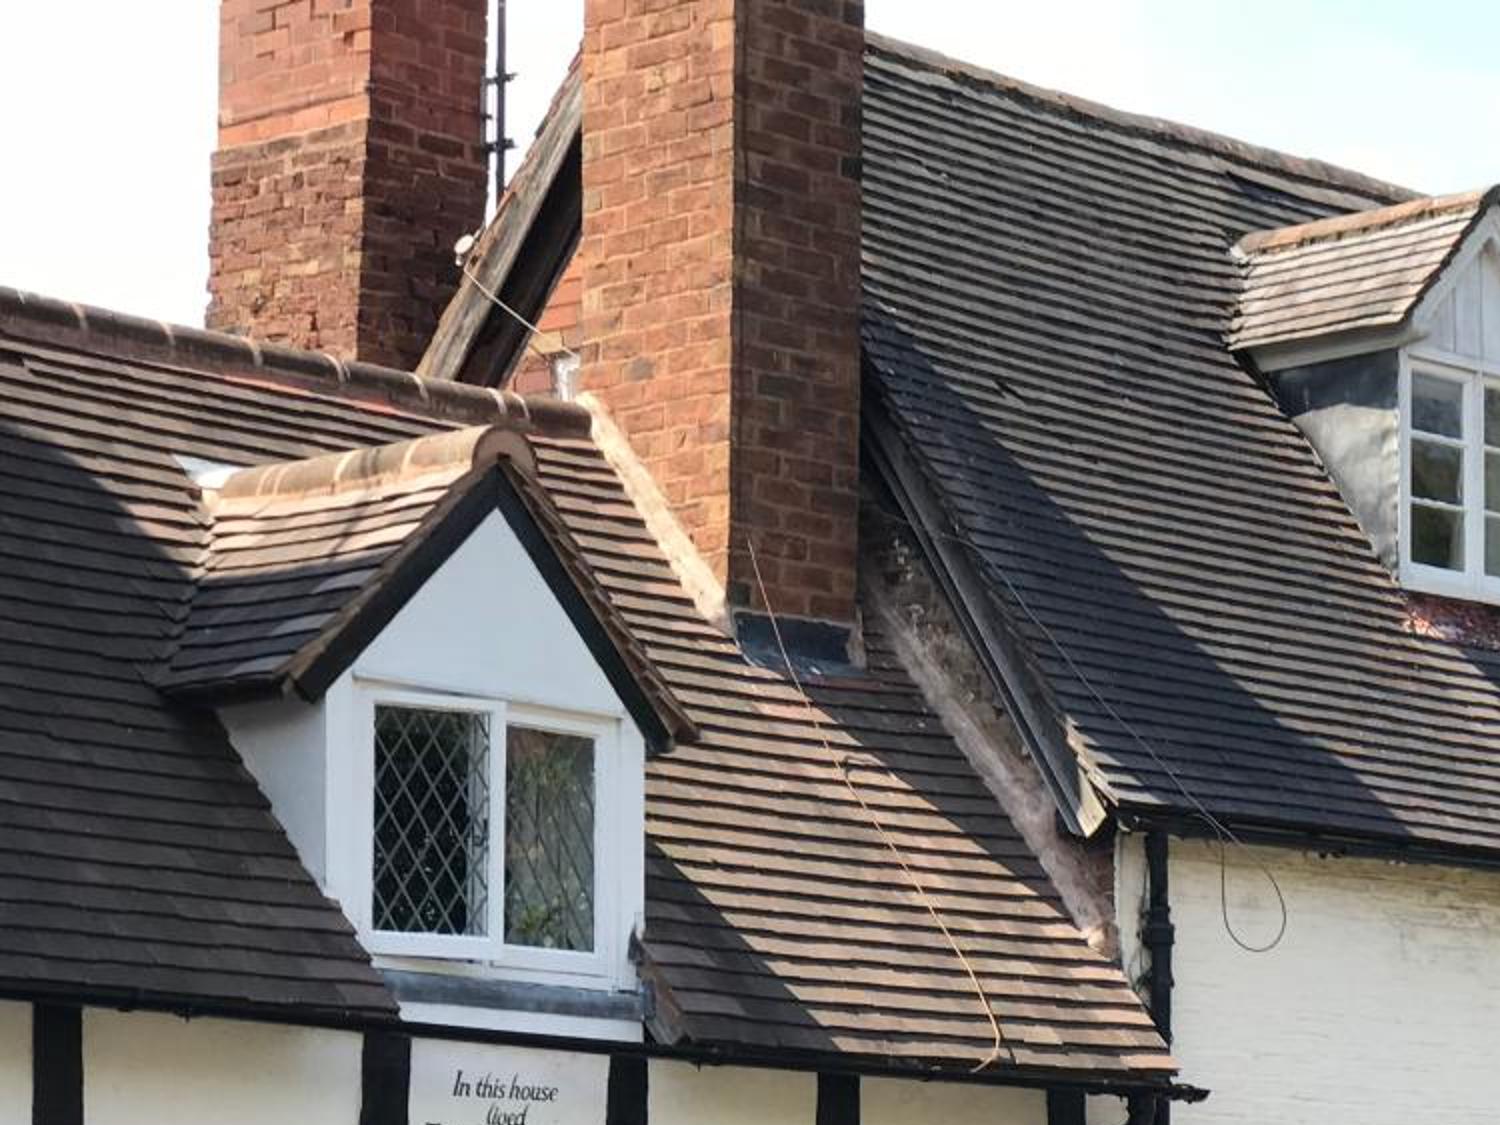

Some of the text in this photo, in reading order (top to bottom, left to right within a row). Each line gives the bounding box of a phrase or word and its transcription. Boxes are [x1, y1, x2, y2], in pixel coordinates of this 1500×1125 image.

[453, 1070, 559, 1101] In this house
